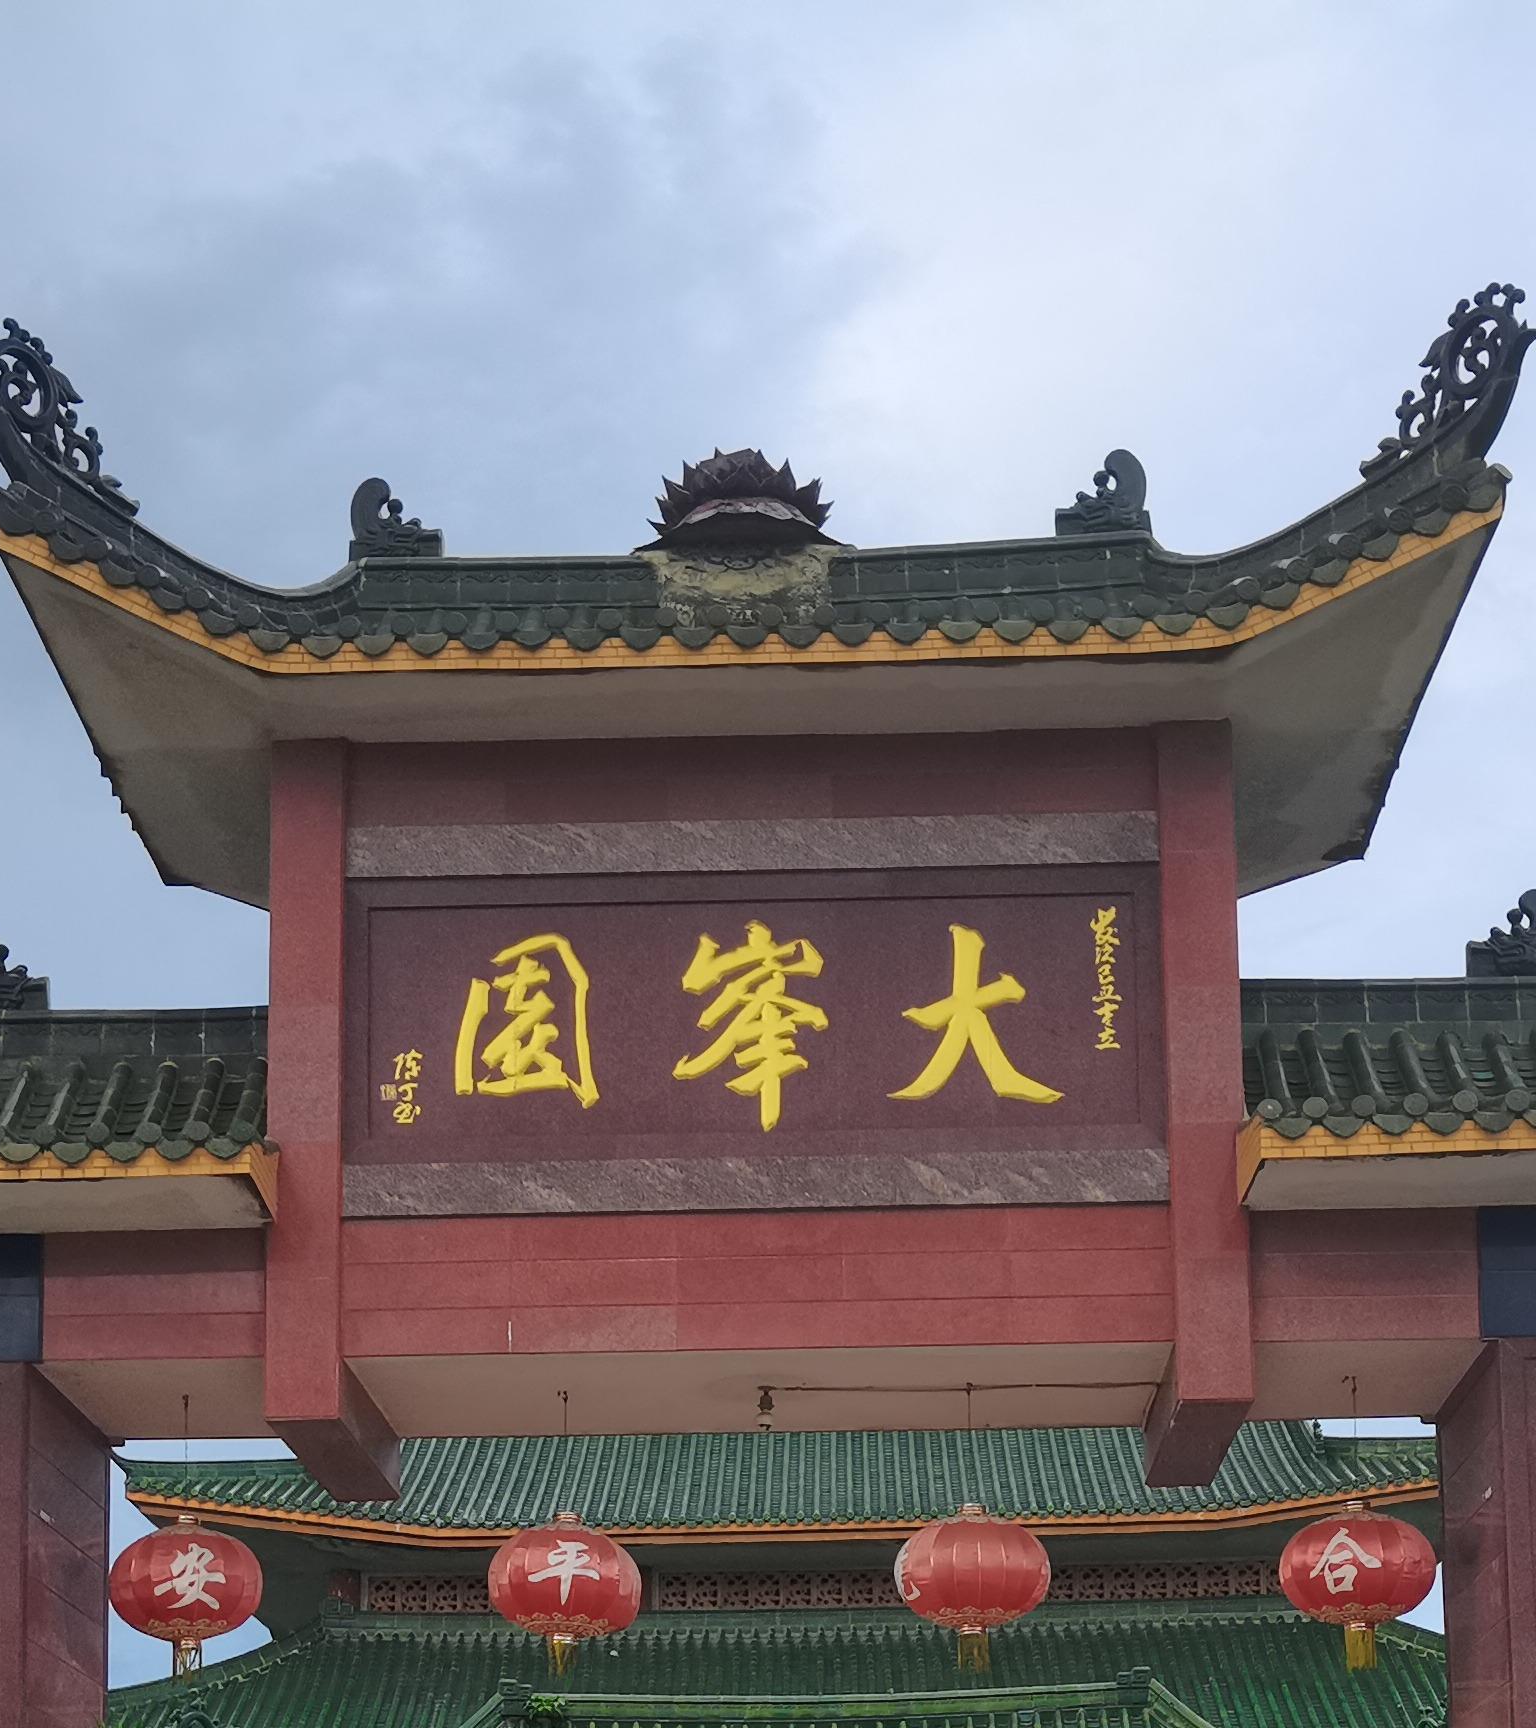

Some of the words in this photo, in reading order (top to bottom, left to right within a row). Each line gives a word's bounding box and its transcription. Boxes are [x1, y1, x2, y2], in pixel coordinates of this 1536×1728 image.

[153, 1541, 228, 1611] 安
[530, 1539, 603, 1606] 平
[1306, 1525, 1382, 1597] 合
